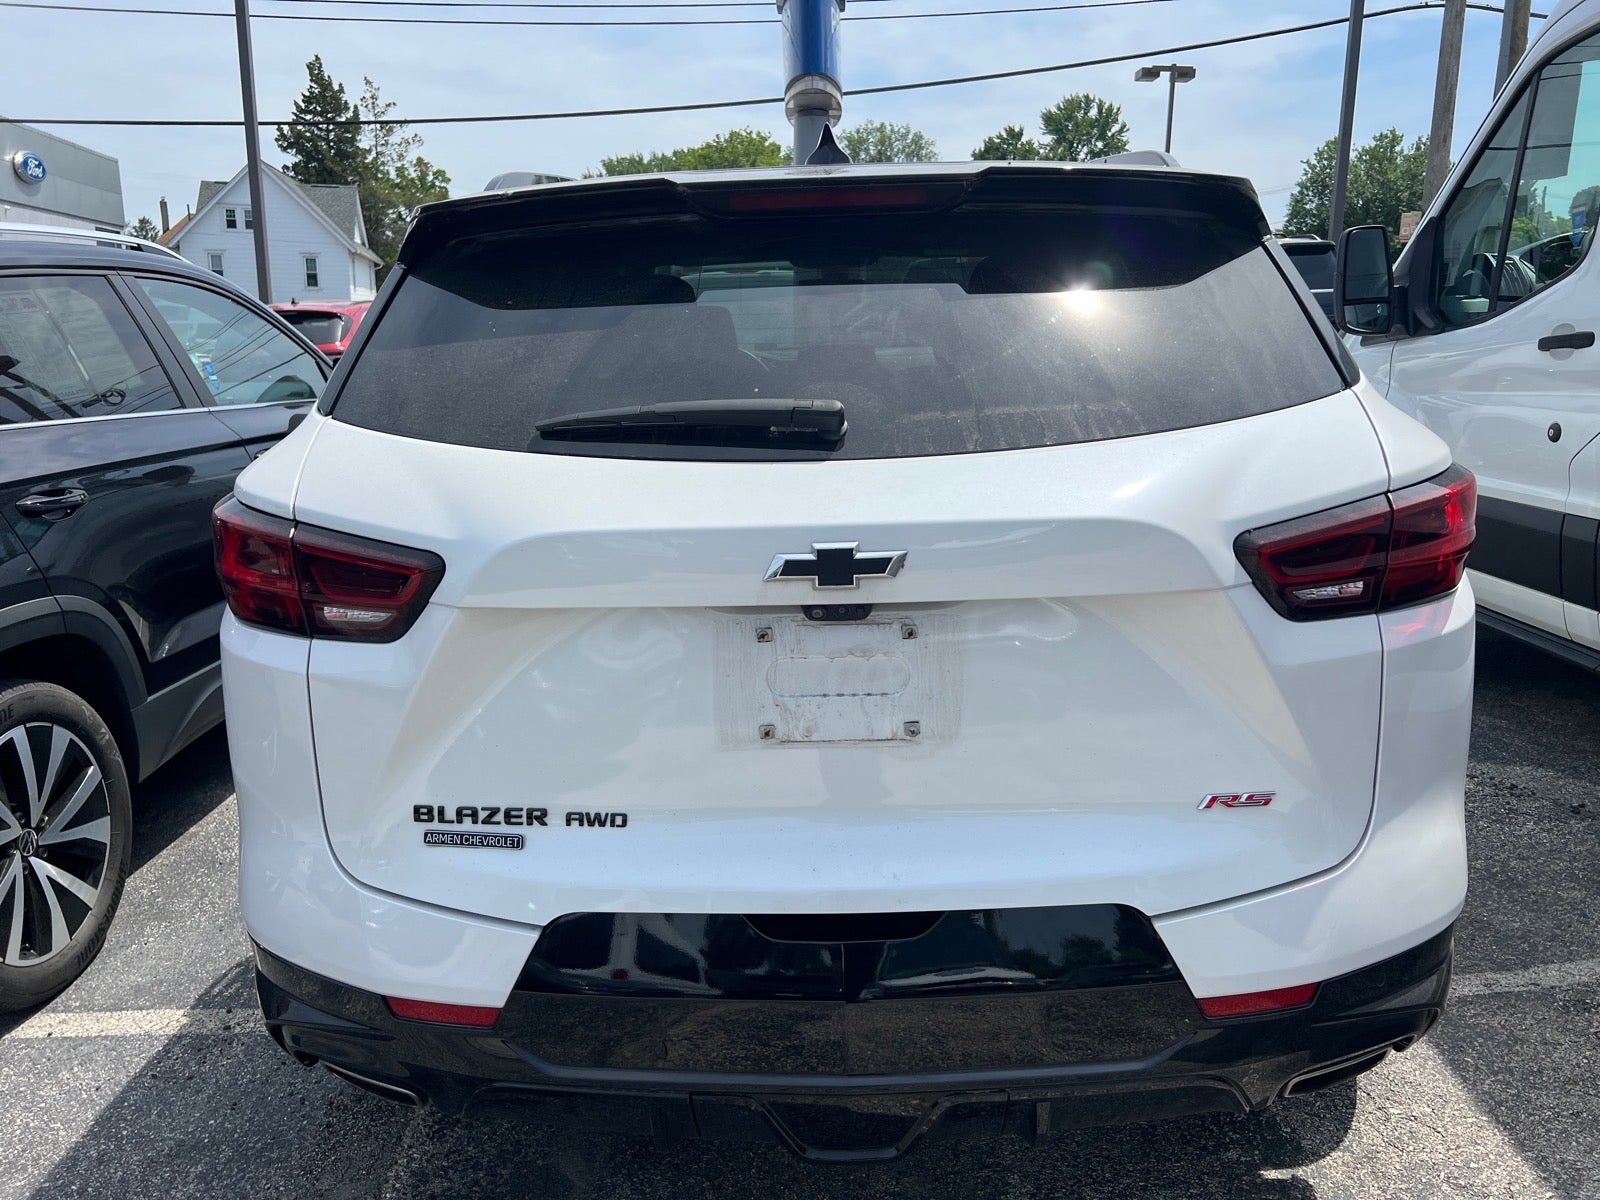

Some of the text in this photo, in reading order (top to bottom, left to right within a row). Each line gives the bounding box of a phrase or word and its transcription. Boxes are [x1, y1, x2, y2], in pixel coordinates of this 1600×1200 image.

[27, 158, 43, 177] Ford
[1198, 791, 1276, 810] RS
[413, 804, 628, 828] BLAZER AWD
[425, 832, 519, 848] ARMEN CHEVROLET
